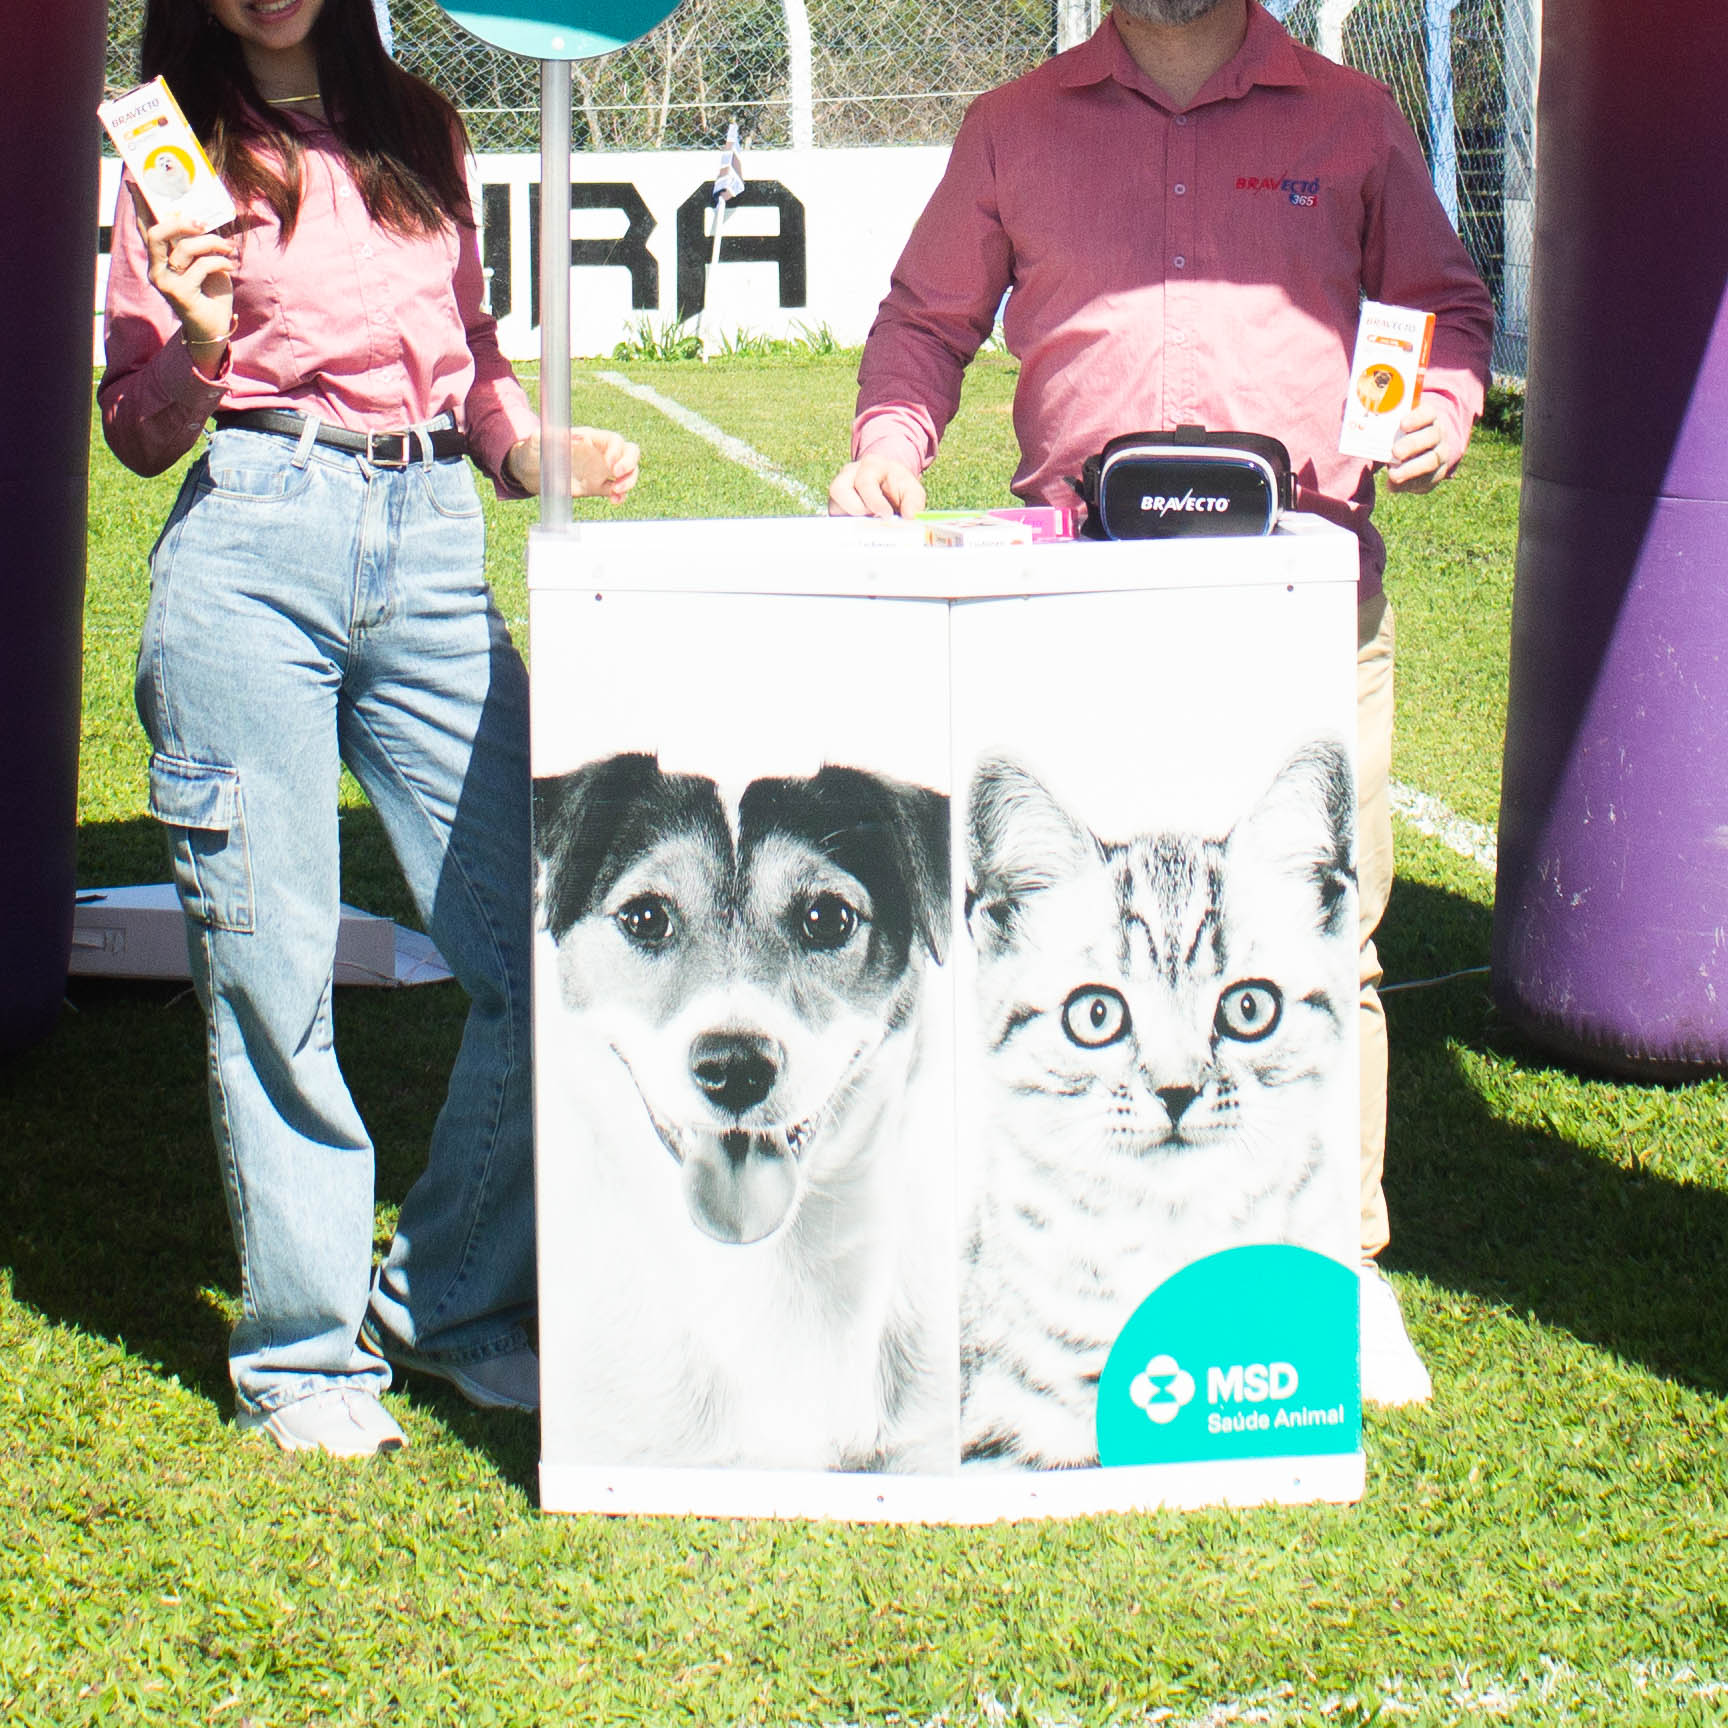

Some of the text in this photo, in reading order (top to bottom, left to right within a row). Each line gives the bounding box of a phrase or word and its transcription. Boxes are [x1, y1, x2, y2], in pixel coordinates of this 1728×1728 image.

[1235, 170, 1320, 196] BRAVECTO
[1292, 194, 1314, 207] 365
[1141, 488, 1229, 518] BRAVECTO
[1207, 1362, 1299, 1404] MSD
[1207, 1403, 1345, 1434] Saúde Animal
